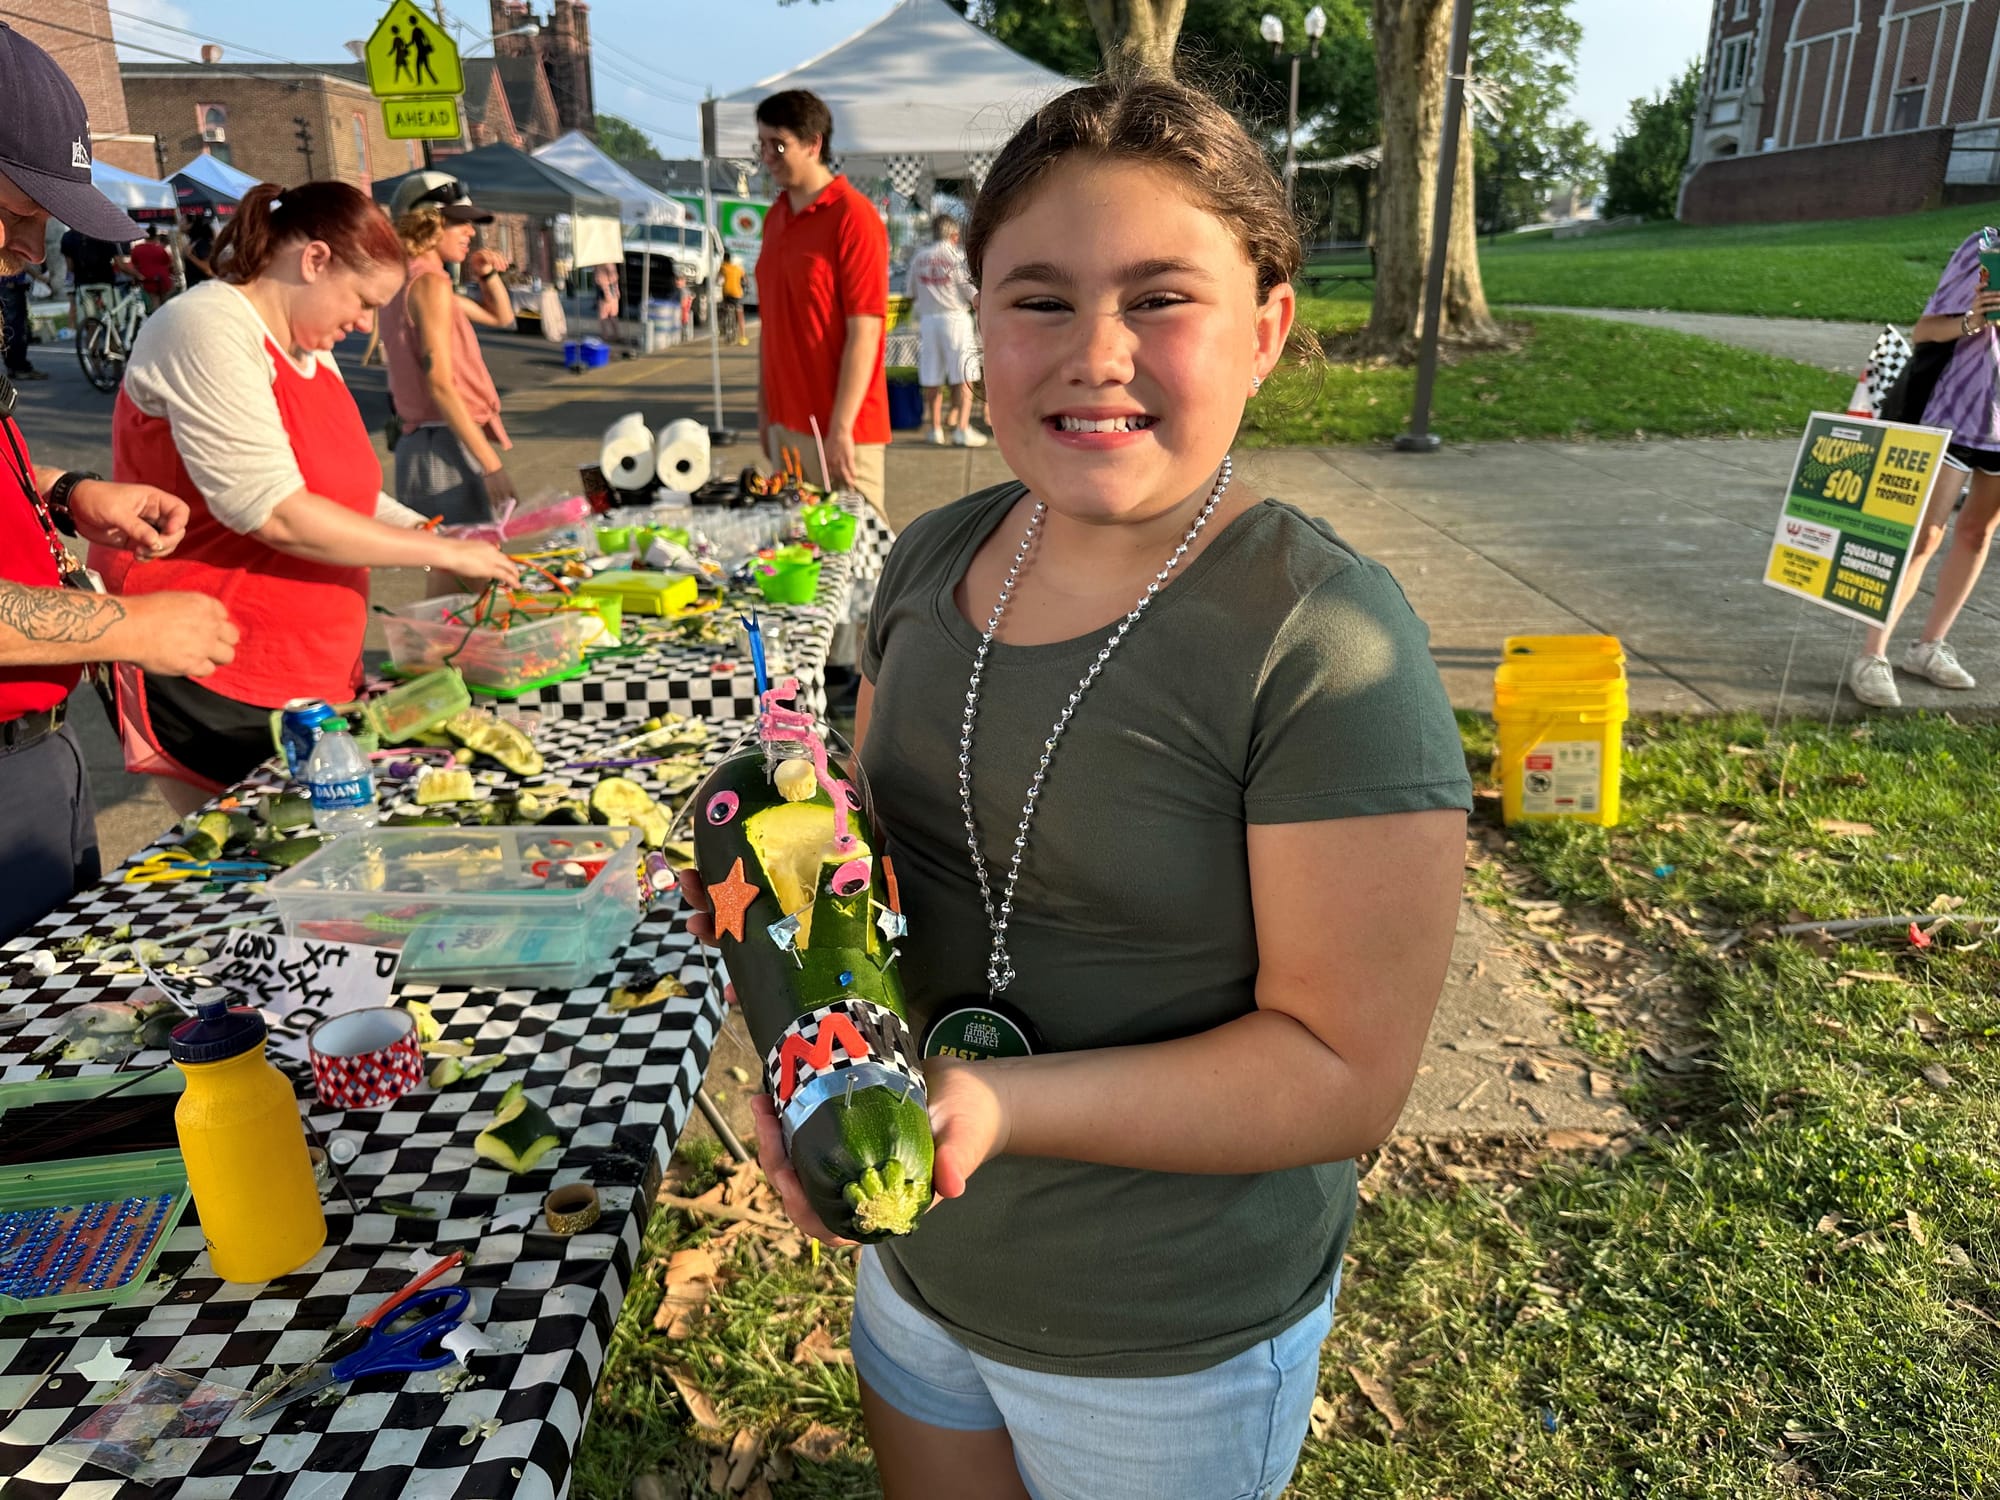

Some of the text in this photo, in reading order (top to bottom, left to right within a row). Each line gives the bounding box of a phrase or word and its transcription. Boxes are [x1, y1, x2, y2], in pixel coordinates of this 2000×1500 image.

[395, 111, 450, 127] AHEAD
[1811, 436, 1870, 465] ZUCCHINI
[1884, 446, 1931, 473] FREE
[1822, 469, 1863, 503] 500
[1878, 472, 1914, 490] PRIZES
[1875, 487, 1917, 506] TROPHIES
[1843, 541, 1879, 563] SQUASH
[1877, 553, 1897, 569] THE
[1840, 555, 1892, 581] COMPETITION
[1836, 567, 1887, 594] WEDNESDAY
[1832, 581, 1857, 599] JULY
[315, 782, 361, 800] DASANI
[969, 1022, 996, 1033] easton
[963, 1034, 999, 1048] market
[939, 1045, 979, 1061] FAST
